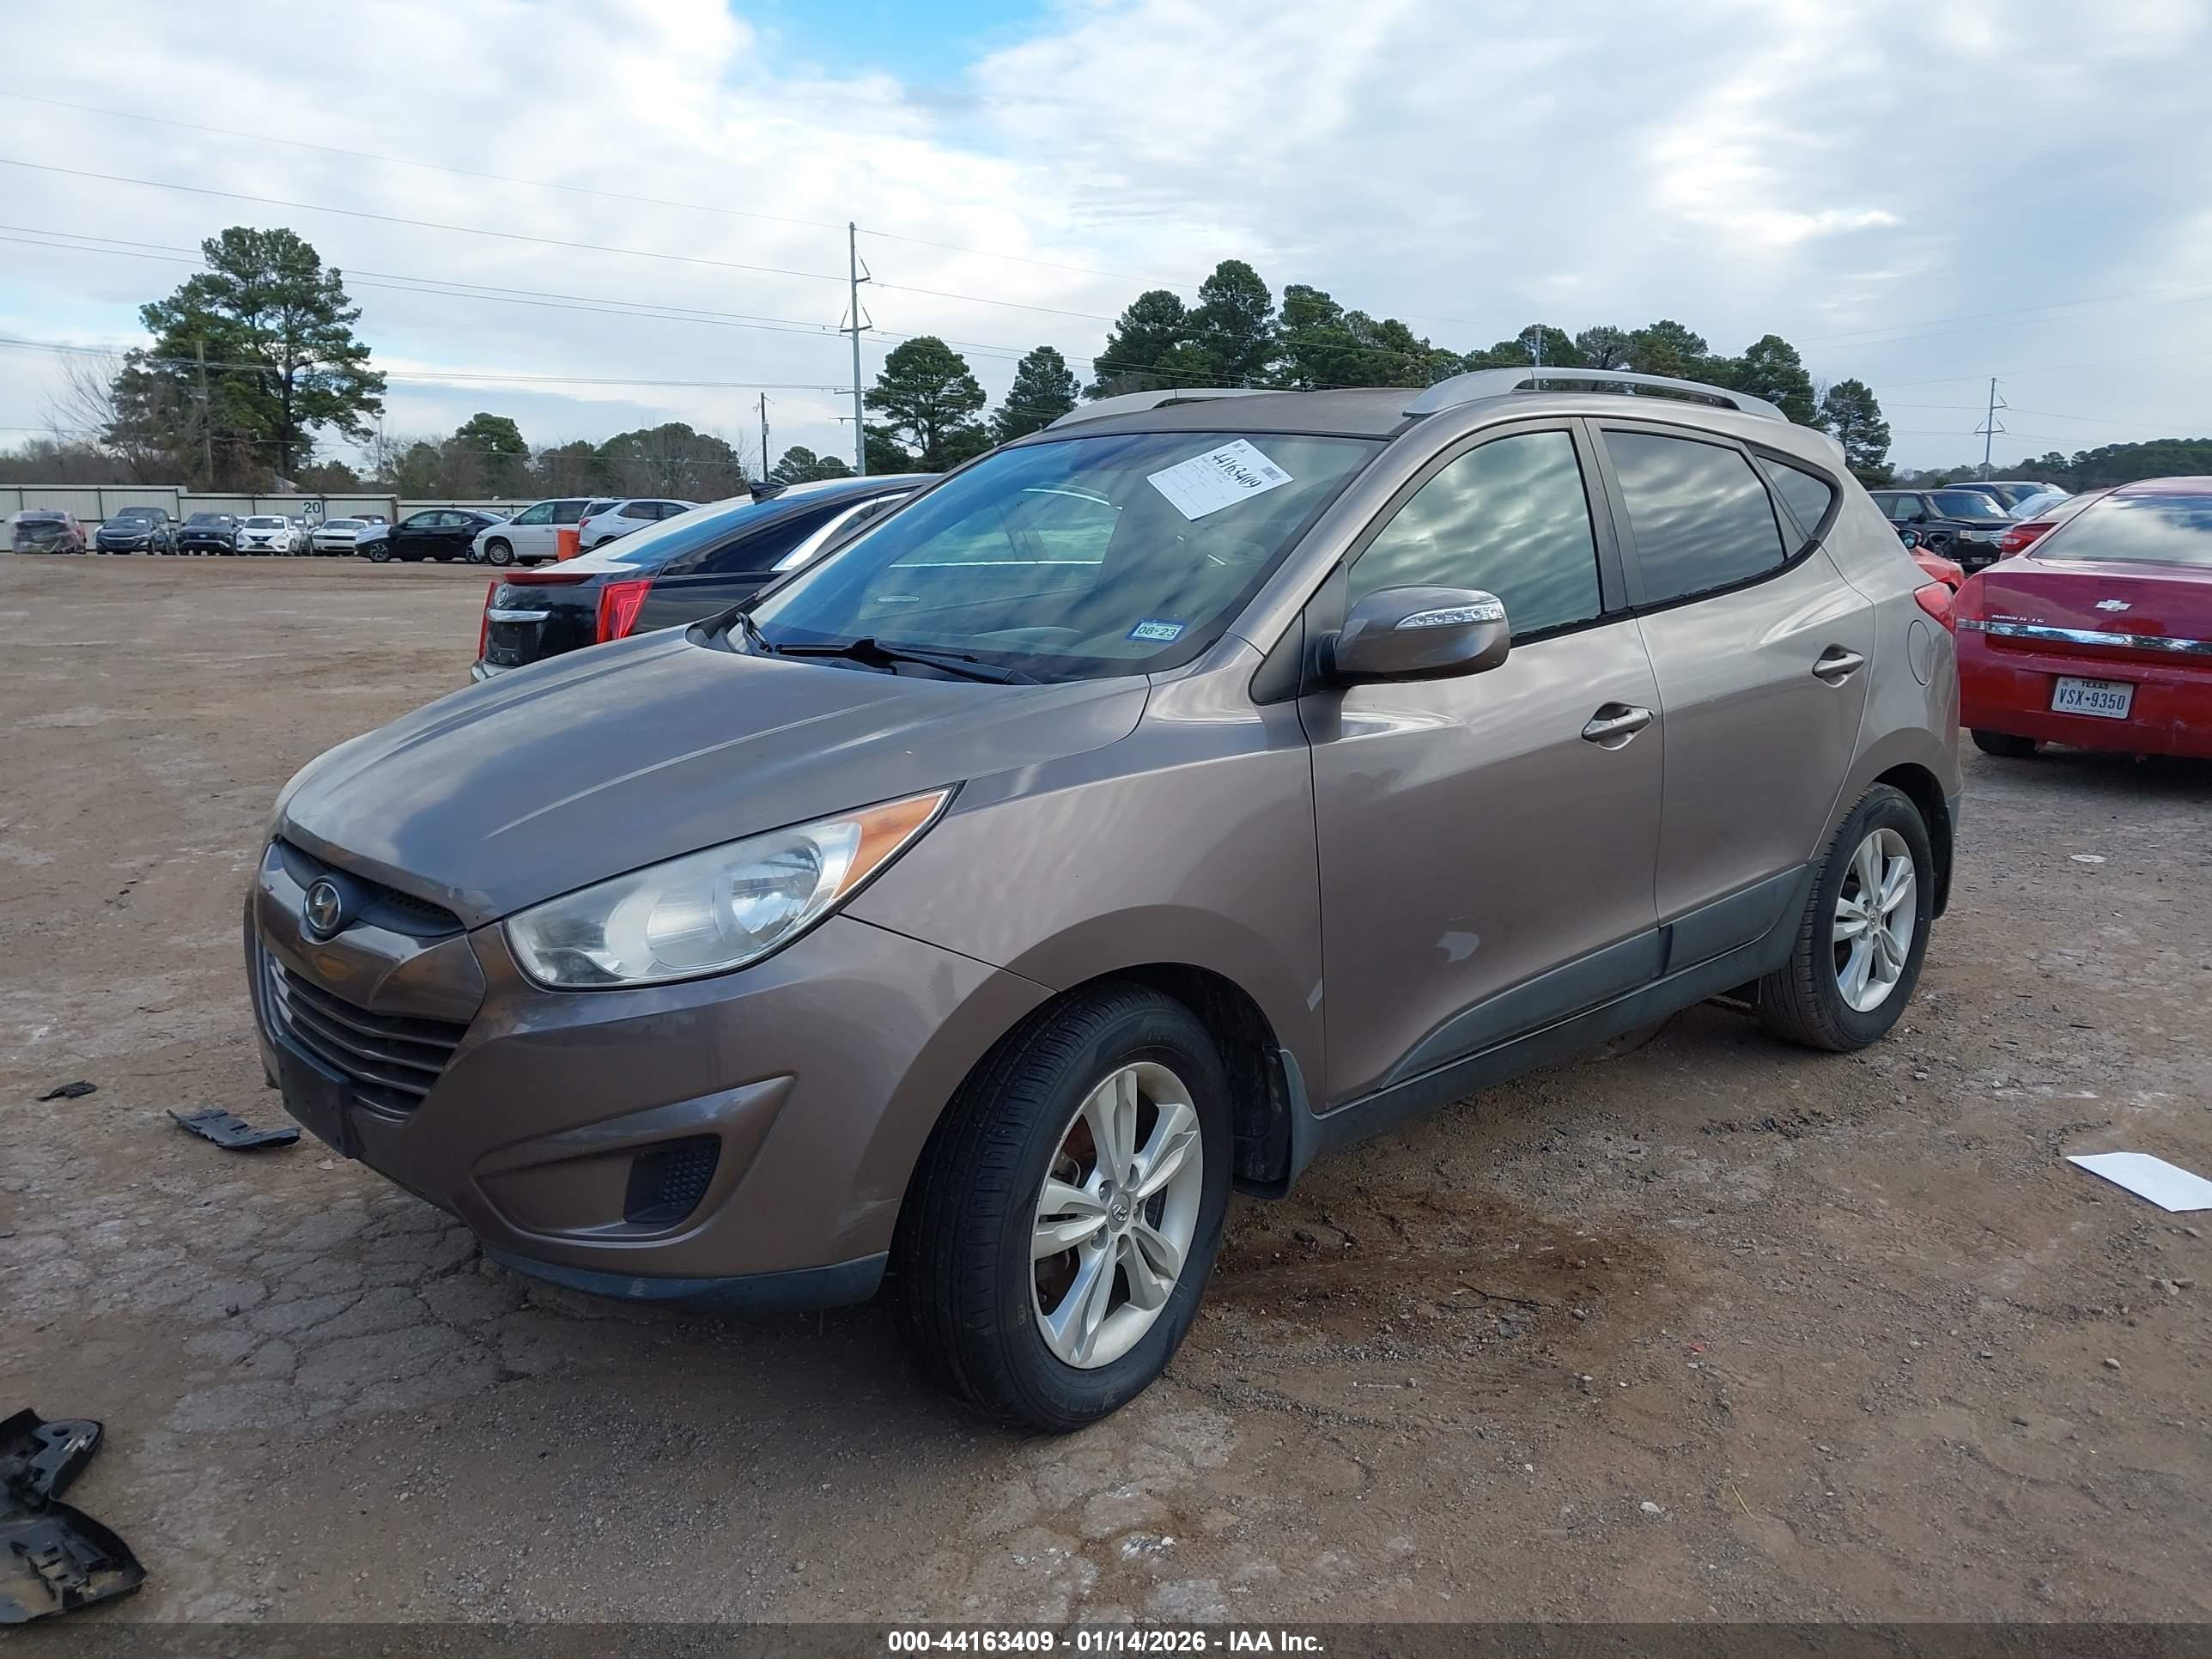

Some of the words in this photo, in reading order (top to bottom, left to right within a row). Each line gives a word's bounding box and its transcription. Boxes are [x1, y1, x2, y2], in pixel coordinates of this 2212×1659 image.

[303, 501, 320, 514] 20
[1137, 626, 1176, 637] 08-23
[2081, 680, 2110, 690] TEXAS
